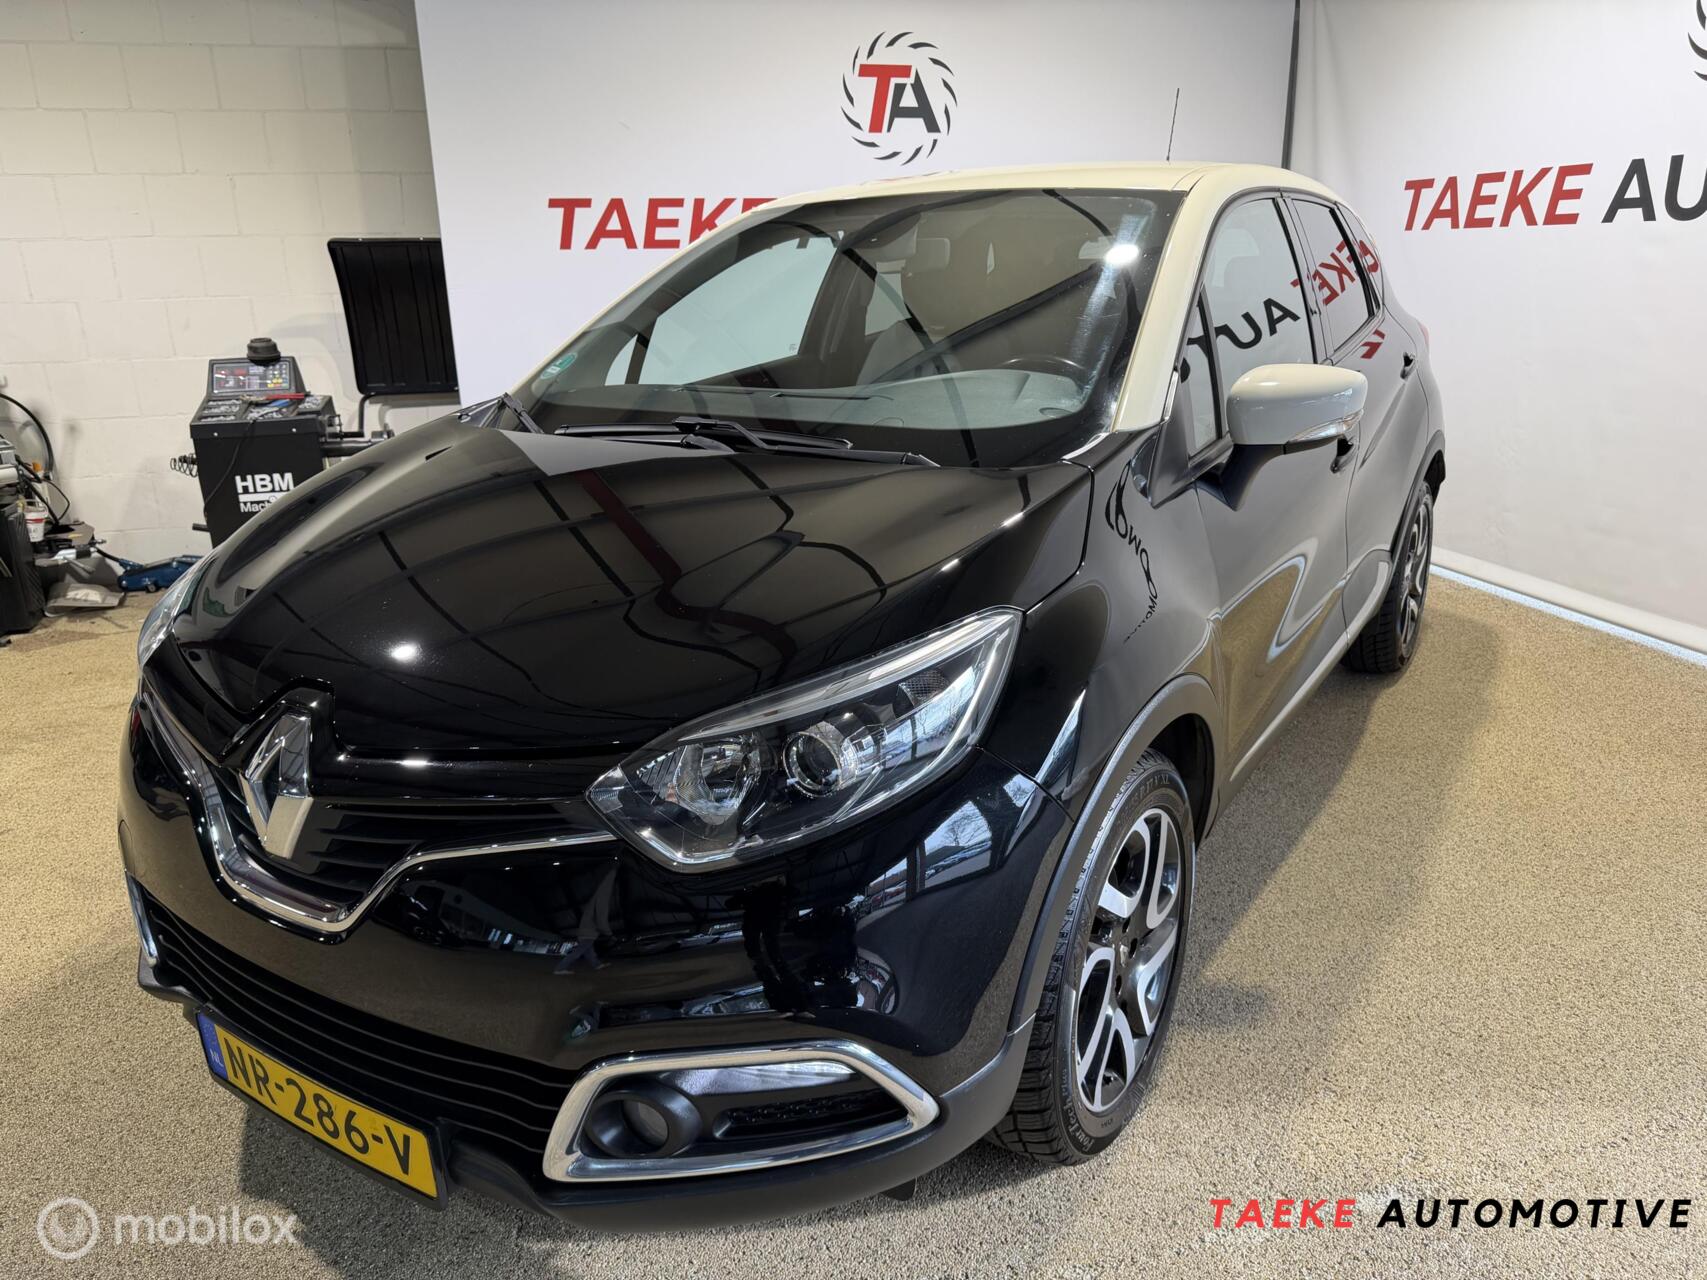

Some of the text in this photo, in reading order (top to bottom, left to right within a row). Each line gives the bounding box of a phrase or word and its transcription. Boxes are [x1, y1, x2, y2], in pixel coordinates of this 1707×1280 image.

[857, 63, 942, 134] TA
[548, 197, 779, 250] TAEK
[1404, 162, 1594, 231] TAEKE
[234, 472, 295, 494] HBM
[209, 1048, 224, 1068] NL
[223, 1037, 412, 1176] NR-286-V
